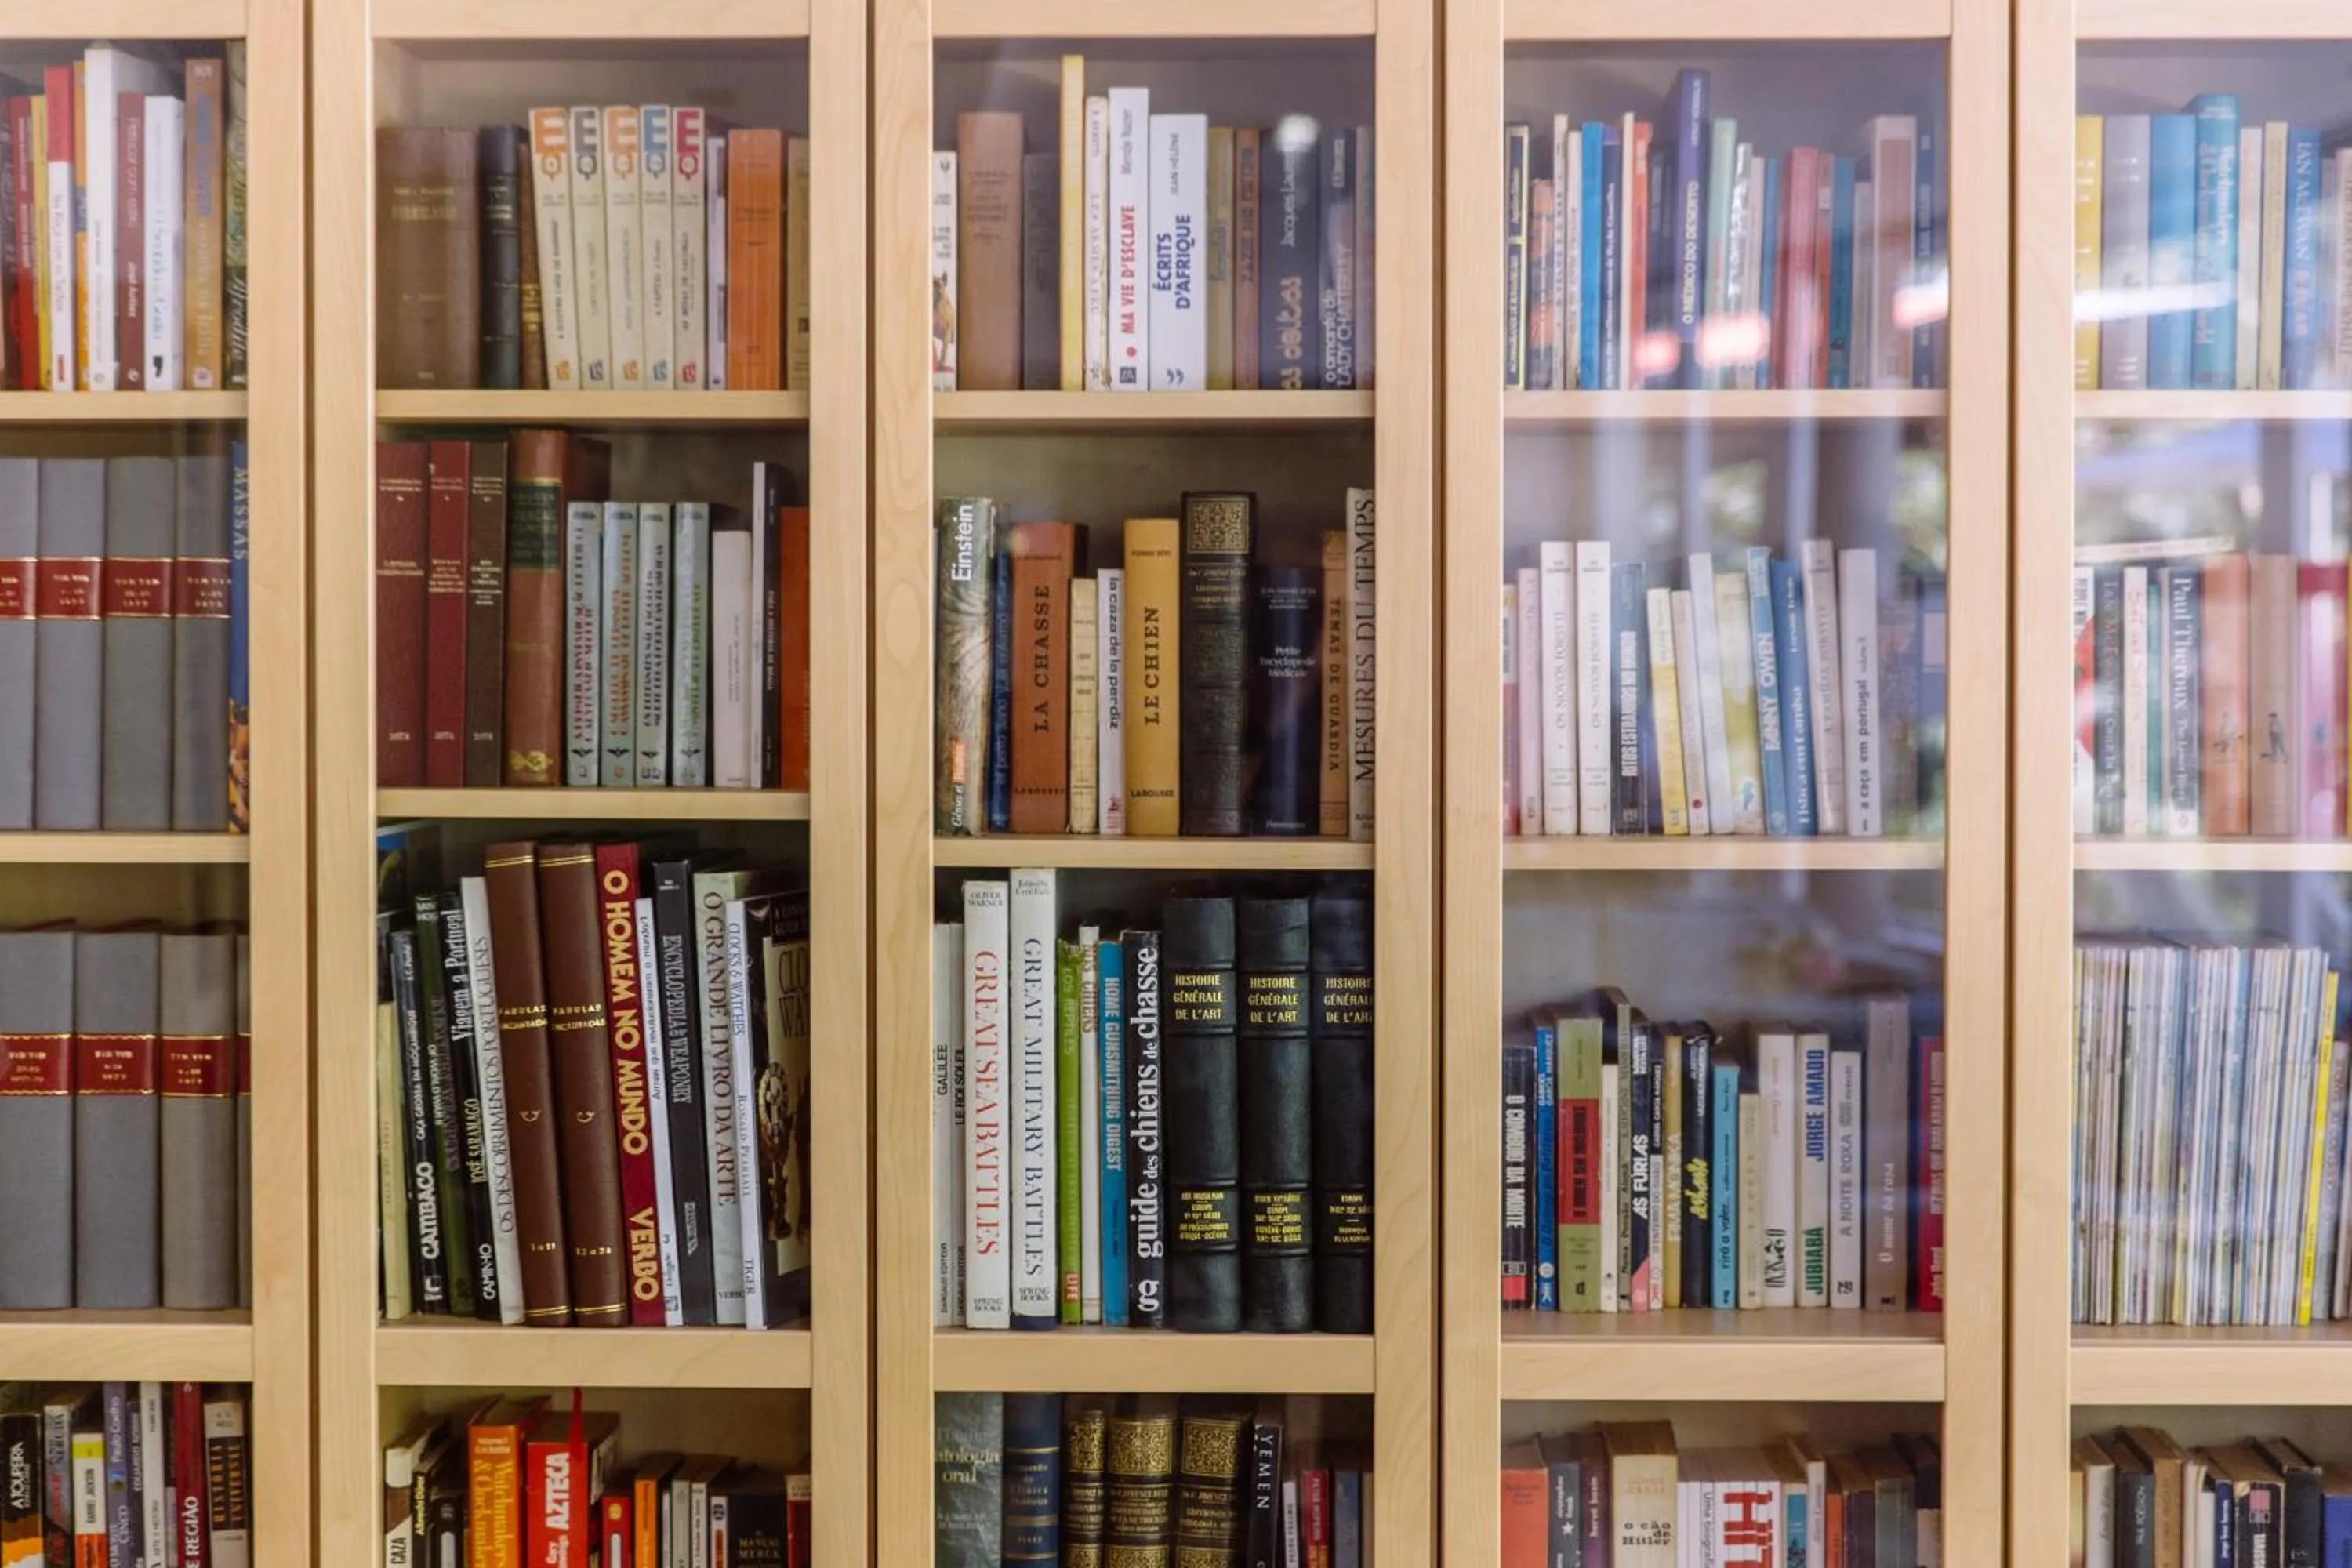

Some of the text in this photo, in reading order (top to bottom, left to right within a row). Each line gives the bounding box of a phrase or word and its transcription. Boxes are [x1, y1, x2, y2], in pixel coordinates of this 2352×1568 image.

[2295, 142, 2313, 175] IAN
[1279, 195, 1296, 247] Jacques
[1682, 181, 1699, 324] O MÉDICO DO DESERTO
[1120, 205, 1136, 334] MA VIE D'ESCLAVE
[1152, 233, 1171, 291] ÉCRITS
[1175, 213, 1195, 310] D'AFRIQUE
[1336, 343, 1352, 387] LADY
[952, 504, 974, 581] Einstein
[1034, 586, 1049, 733] LA CHASSE
[1108, 577, 1121, 729] la caza de la perdiz
[1145, 606, 1160, 724] LE CHIEN
[1354, 499, 1375, 780] MESURES DU TEMPS
[2172, 576, 2193, 713] Paul Theroux
[1329, 598, 1341, 771] TEMAS DE GUARDIA
[1757, 633, 1779, 750] FANNY OWEN
[1621, 746, 1637, 776] RITOS
[1856, 679, 1871, 810] a caça em portugal
[442, 909, 474, 1041] Viagem a Portugal
[604, 870, 648, 1155] O HOMEM NO MUNDO
[728, 922, 745, 1036] CLOCKS WATCHES
[1062, 967, 1076, 1055] LOS REPTILES
[1173, 989, 1224, 1004] GÉNÉRALE
[1174, 975, 1220, 985] HISTOIRE
[1247, 992, 1298, 1006] GÉNÉRALE
[1250, 977, 1296, 989] HISTOIRE
[662, 935, 691, 1104] ENCYCLOPEDIA WEAPONRY
[704, 891, 736, 1207] O GRANDE LIVRO DA ARTE
[1175, 1008, 1221, 1020] DE L'ART
[1250, 1010, 1298, 1022] DE L'ART
[1326, 1011, 1340, 1023] DE
[412, 1069, 423, 1081] EM
[412, 1084, 424, 1118] GROSSA
[428, 1044, 441, 1117] OF WORLD WAR
[474, 936, 514, 1233] OS DESCOBRIMENTOS PORTUGUESES
[937, 1044, 949, 1095] GALILEE
[955, 1045, 965, 1125] LE ROI SOLEIL
[975, 951, 1000, 1256] GREAT SEA BATTLES
[1023, 938, 1044, 1276] GREAT MILITARY BATTLES
[1105, 978, 1121, 1171] HOME GUNSMITHING DIGEST
[1130, 947, 1163, 1259] guide des chiens de chasse
[1806, 1050, 1824, 1162] JORGE AMADO
[415, 1120, 426, 1141] CAÇA
[465, 1098, 487, 1183] JOSÉ SARAMAGO
[1505, 1095, 1526, 1229] O COMBOIO DA MORTE
[416, 1161, 441, 1260] CAMBACO
[1632, 1196, 1649, 1220] AS
[1840, 1134, 1853, 1236] A NOITE ROXA
[479, 1243, 497, 1300] CAMINHO
[629, 1207, 658, 1301] VERBO
[744, 1258, 756, 1296] TIGER
[1066, 1273, 1079, 1301] LIFE
[1804, 1226, 1824, 1295] JUBIABÁ
[110, 1396, 123, 1463] Paulo Coelho
[545, 1452, 571, 1531] AZTECA
[942, 1461, 978, 1483] oral
[1257, 1434, 1274, 1509] YEMEN
[1704, 1492, 1715, 1518] Uma
[118, 1504, 130, 1544] CINCO
[182, 1495, 200, 1555] REGIÃO
[390, 1537, 406, 1565] CAZA
[1622, 1536, 1671, 1546] Hitler
[1640, 1521, 1671, 1530] cão
[1653, 1529, 1671, 1537] de
